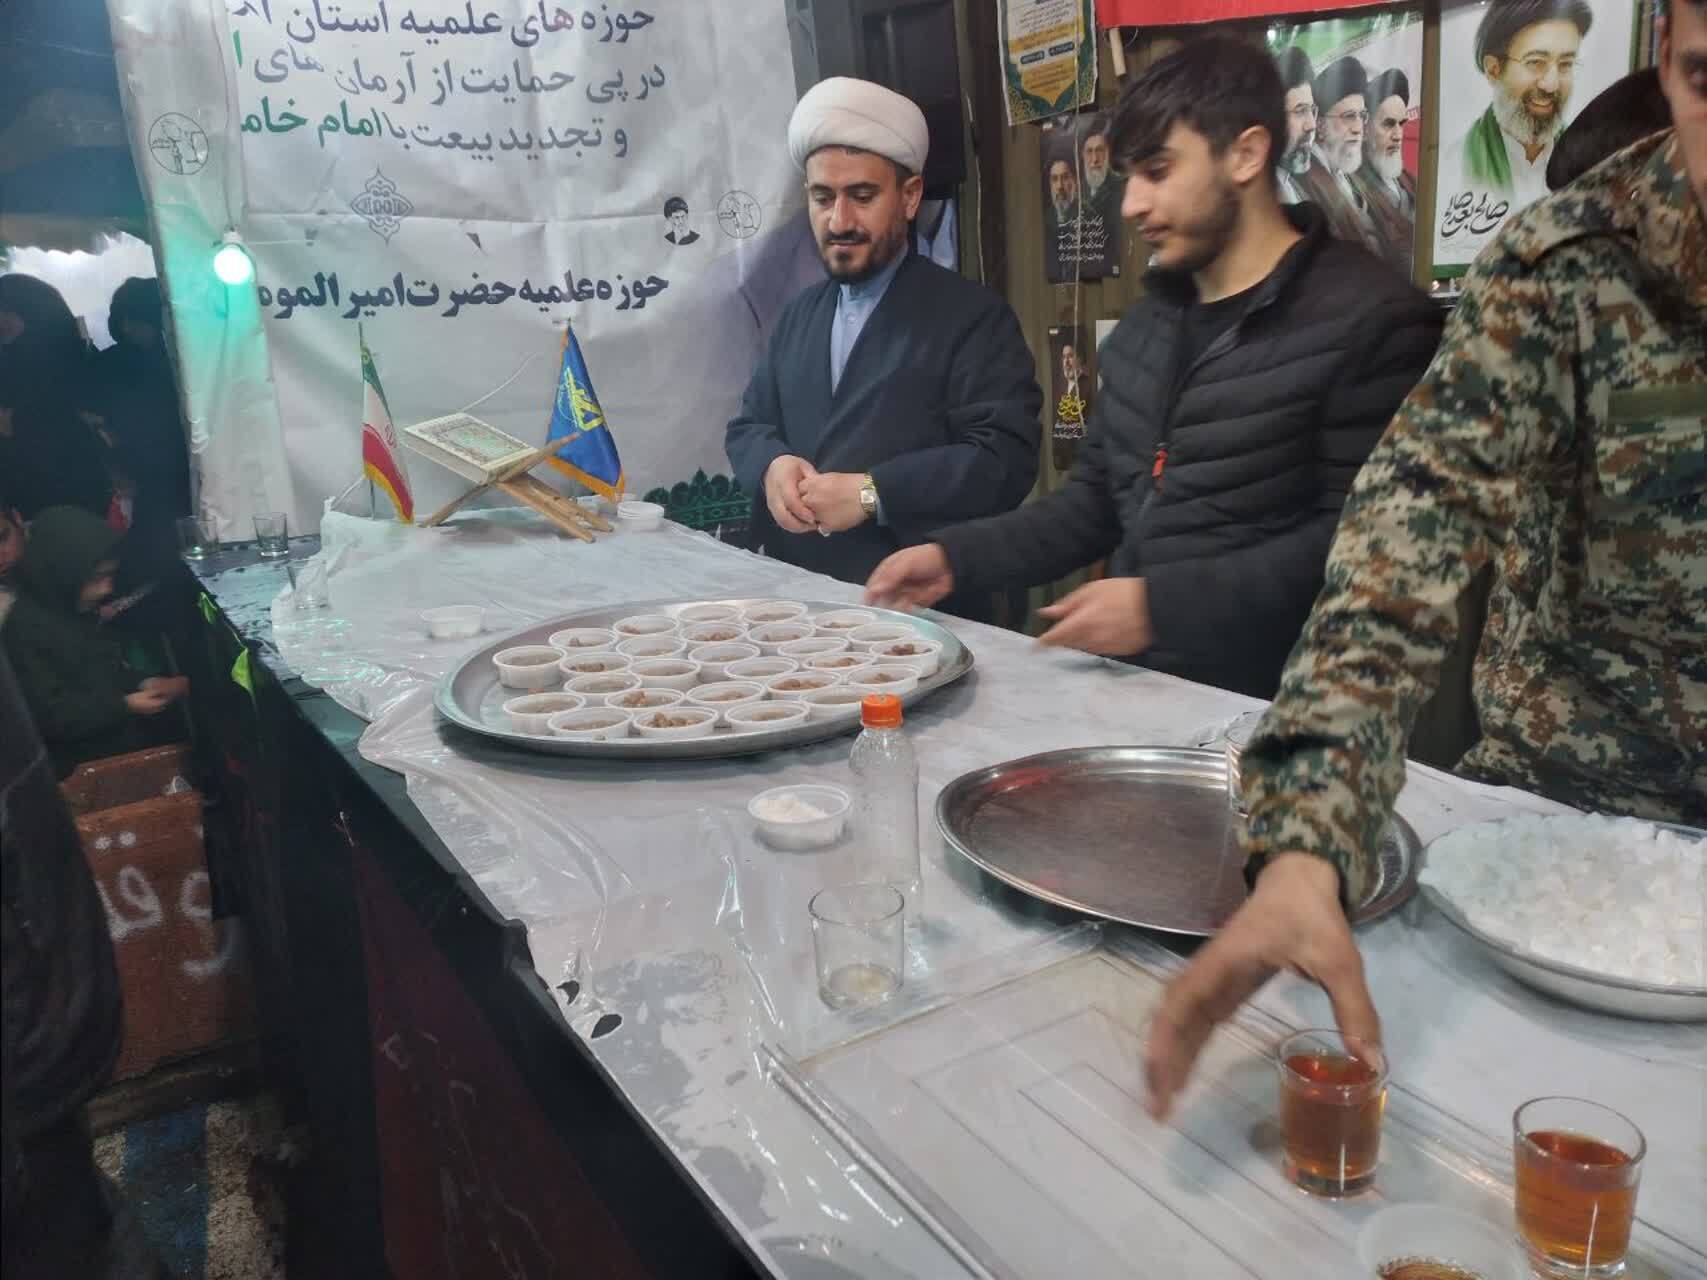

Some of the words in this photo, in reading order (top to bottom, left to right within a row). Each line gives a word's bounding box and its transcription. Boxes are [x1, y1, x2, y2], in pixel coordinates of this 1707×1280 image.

[286, 0, 389, 43] استان
[400, 0, 503, 45] علمیه
[511, 0, 575, 47] های
[582, 4, 655, 43] حوزه
[334, 51, 416, 104] آرمان
[430, 58, 453, 105] از
[460, 58, 576, 103] حمایت
[586, 68, 629, 104] پی
[634, 63, 666, 100] در
[240, 96, 308, 133] خام
[317, 99, 383, 149] امام
[381, 111, 410, 150] با
[411, 124, 493, 161] بیعت
[499, 117, 604, 160] تجدید
[613, 128, 628, 158] و
[1470, 192, 1509, 235] صالح
[257, 271, 340, 319] الموم
[341, 271, 405, 319] امیر
[406, 271, 517, 318] حضرت
[519, 269, 594, 313] علمیه
[596, 273, 669, 311] حوزه
